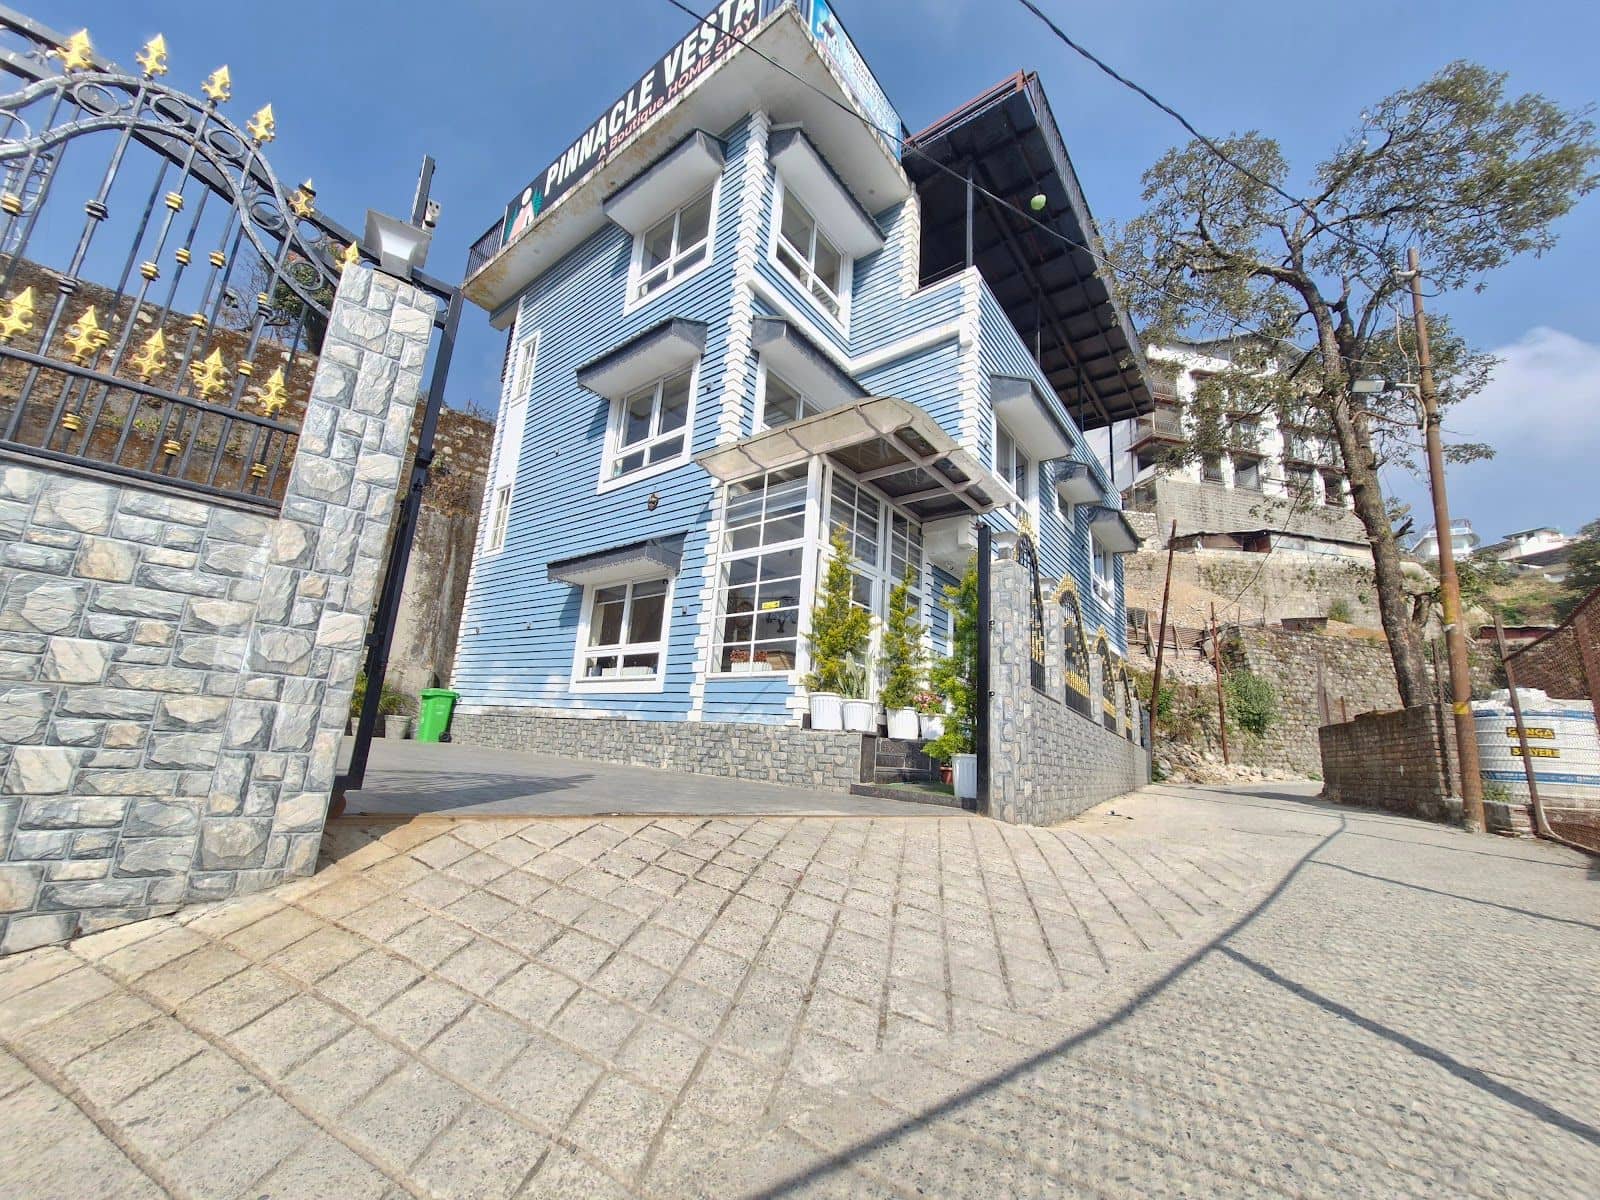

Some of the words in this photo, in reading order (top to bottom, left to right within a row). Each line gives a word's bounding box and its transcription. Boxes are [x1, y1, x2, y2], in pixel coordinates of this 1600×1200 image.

[544, 70, 655, 197] PINNACLE
[664, 0, 755, 87] VESTA
[598, 146, 606, 160] A
[610, 96, 664, 150] Boutique
[668, 51, 711, 99] HOME
[714, 13, 755, 57] STAY
[1508, 728, 1554, 737] GNGA
